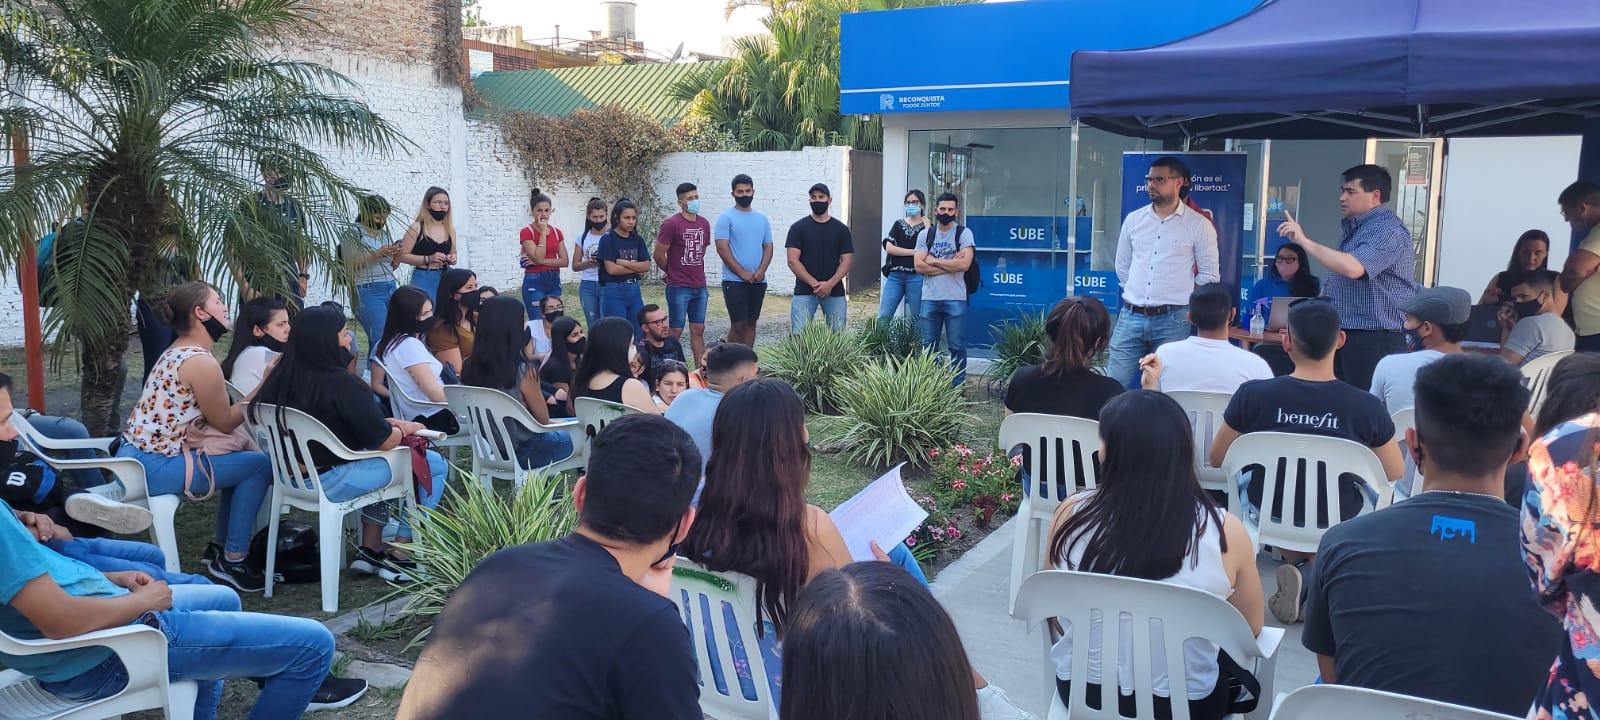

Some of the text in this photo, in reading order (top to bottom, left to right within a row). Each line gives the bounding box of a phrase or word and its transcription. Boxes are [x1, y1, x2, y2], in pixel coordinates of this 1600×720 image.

[899, 95, 945, 103] RECONQUISTA
[1009, 226, 1045, 240] SUBE
[993, 272, 1023, 284] SUBE
[1074, 275, 1106, 287] SUBE
[1276, 407, 1340, 429] benefit
